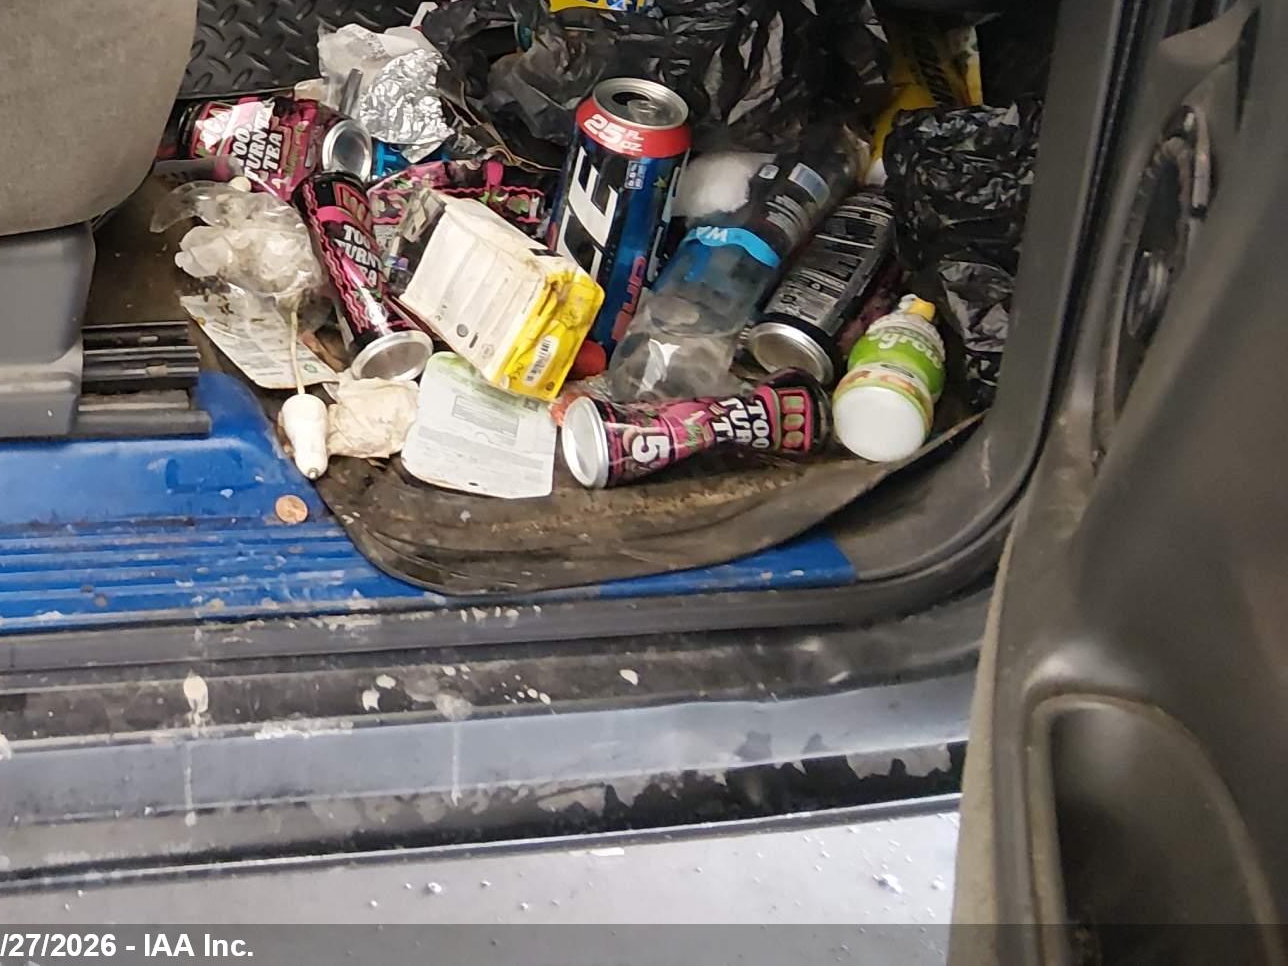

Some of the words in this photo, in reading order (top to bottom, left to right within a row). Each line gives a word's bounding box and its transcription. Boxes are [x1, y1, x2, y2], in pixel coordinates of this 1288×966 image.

[263, 131, 283, 171] TEA
[583, 113, 623, 153] 25
[555, 145, 619, 283] CE
[747, 399, 770, 450] TOO
